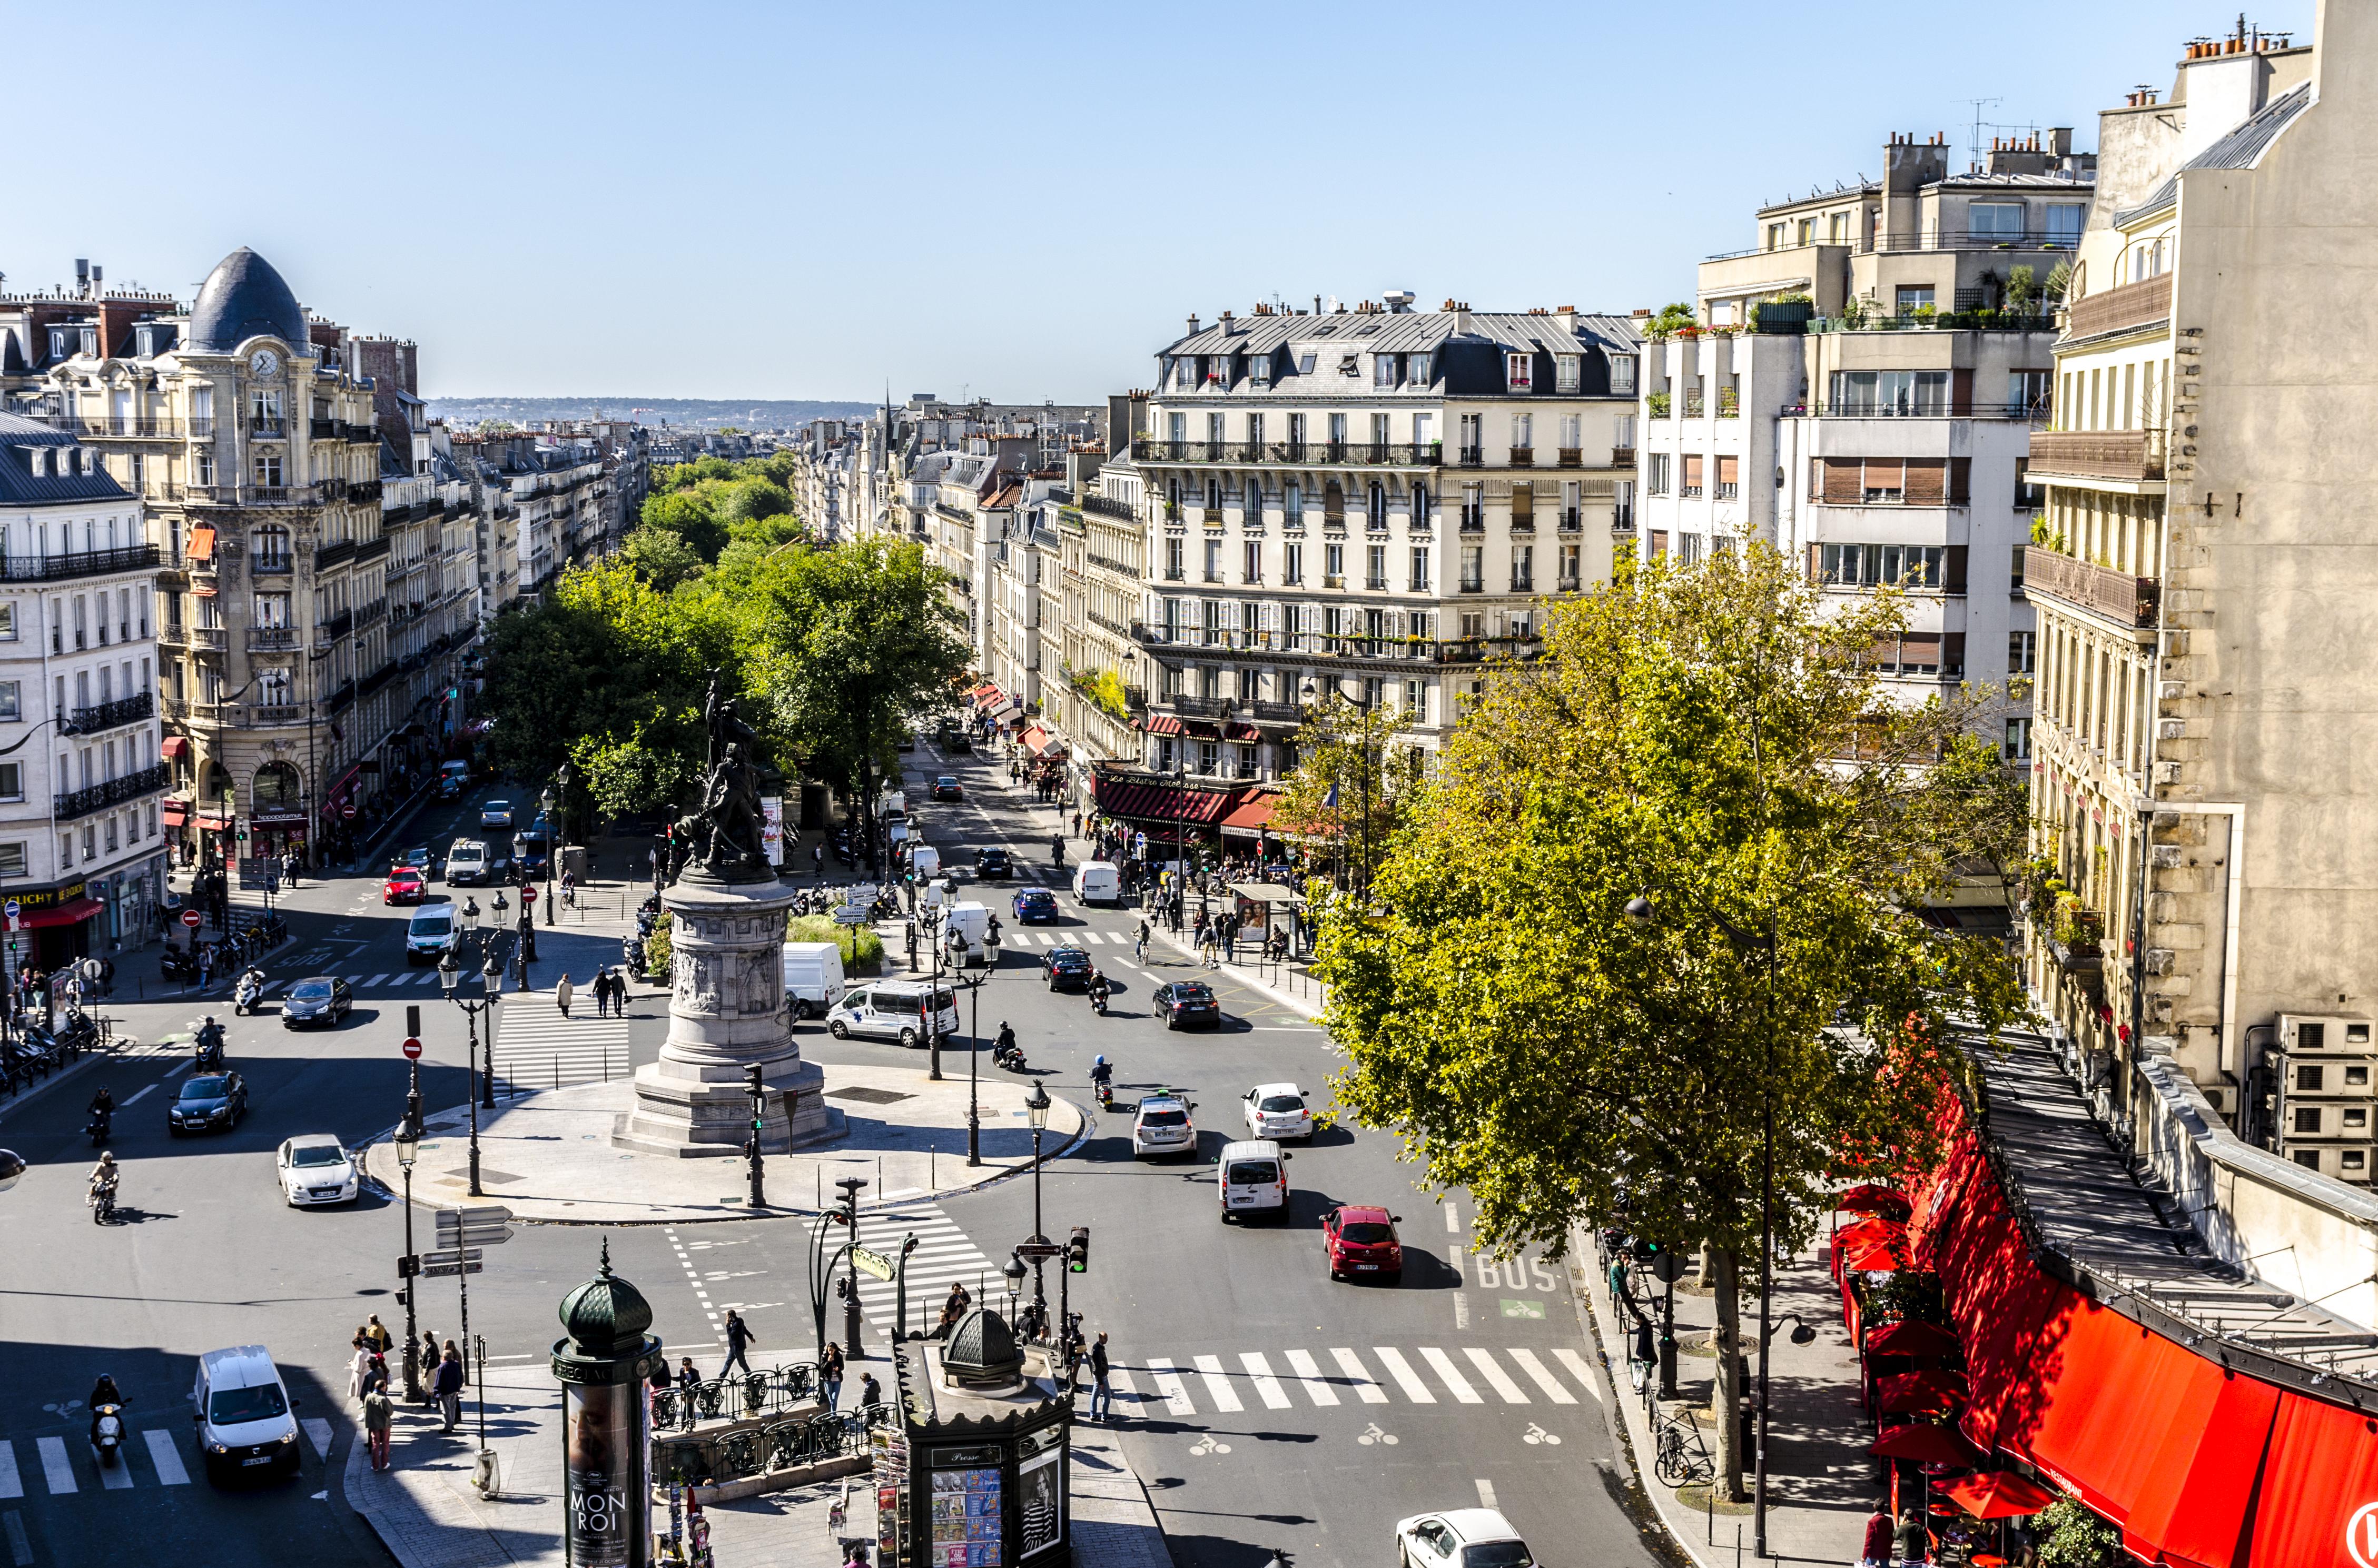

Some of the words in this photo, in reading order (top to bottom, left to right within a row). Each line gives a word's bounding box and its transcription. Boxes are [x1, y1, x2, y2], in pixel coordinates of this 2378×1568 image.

[1126, 777, 1157, 785] Bistro
[1160, 779, 1199, 789] Melose
[273, 952, 333, 968] BUS
[1476, 1254, 1556, 1292] BUS
[951, 1453, 981, 1462] Presse
[2050, 1468, 2082, 1499] RESTAURANT
[571, 1491, 625, 1512] MON
[579, 1512, 616, 1531] ROI
